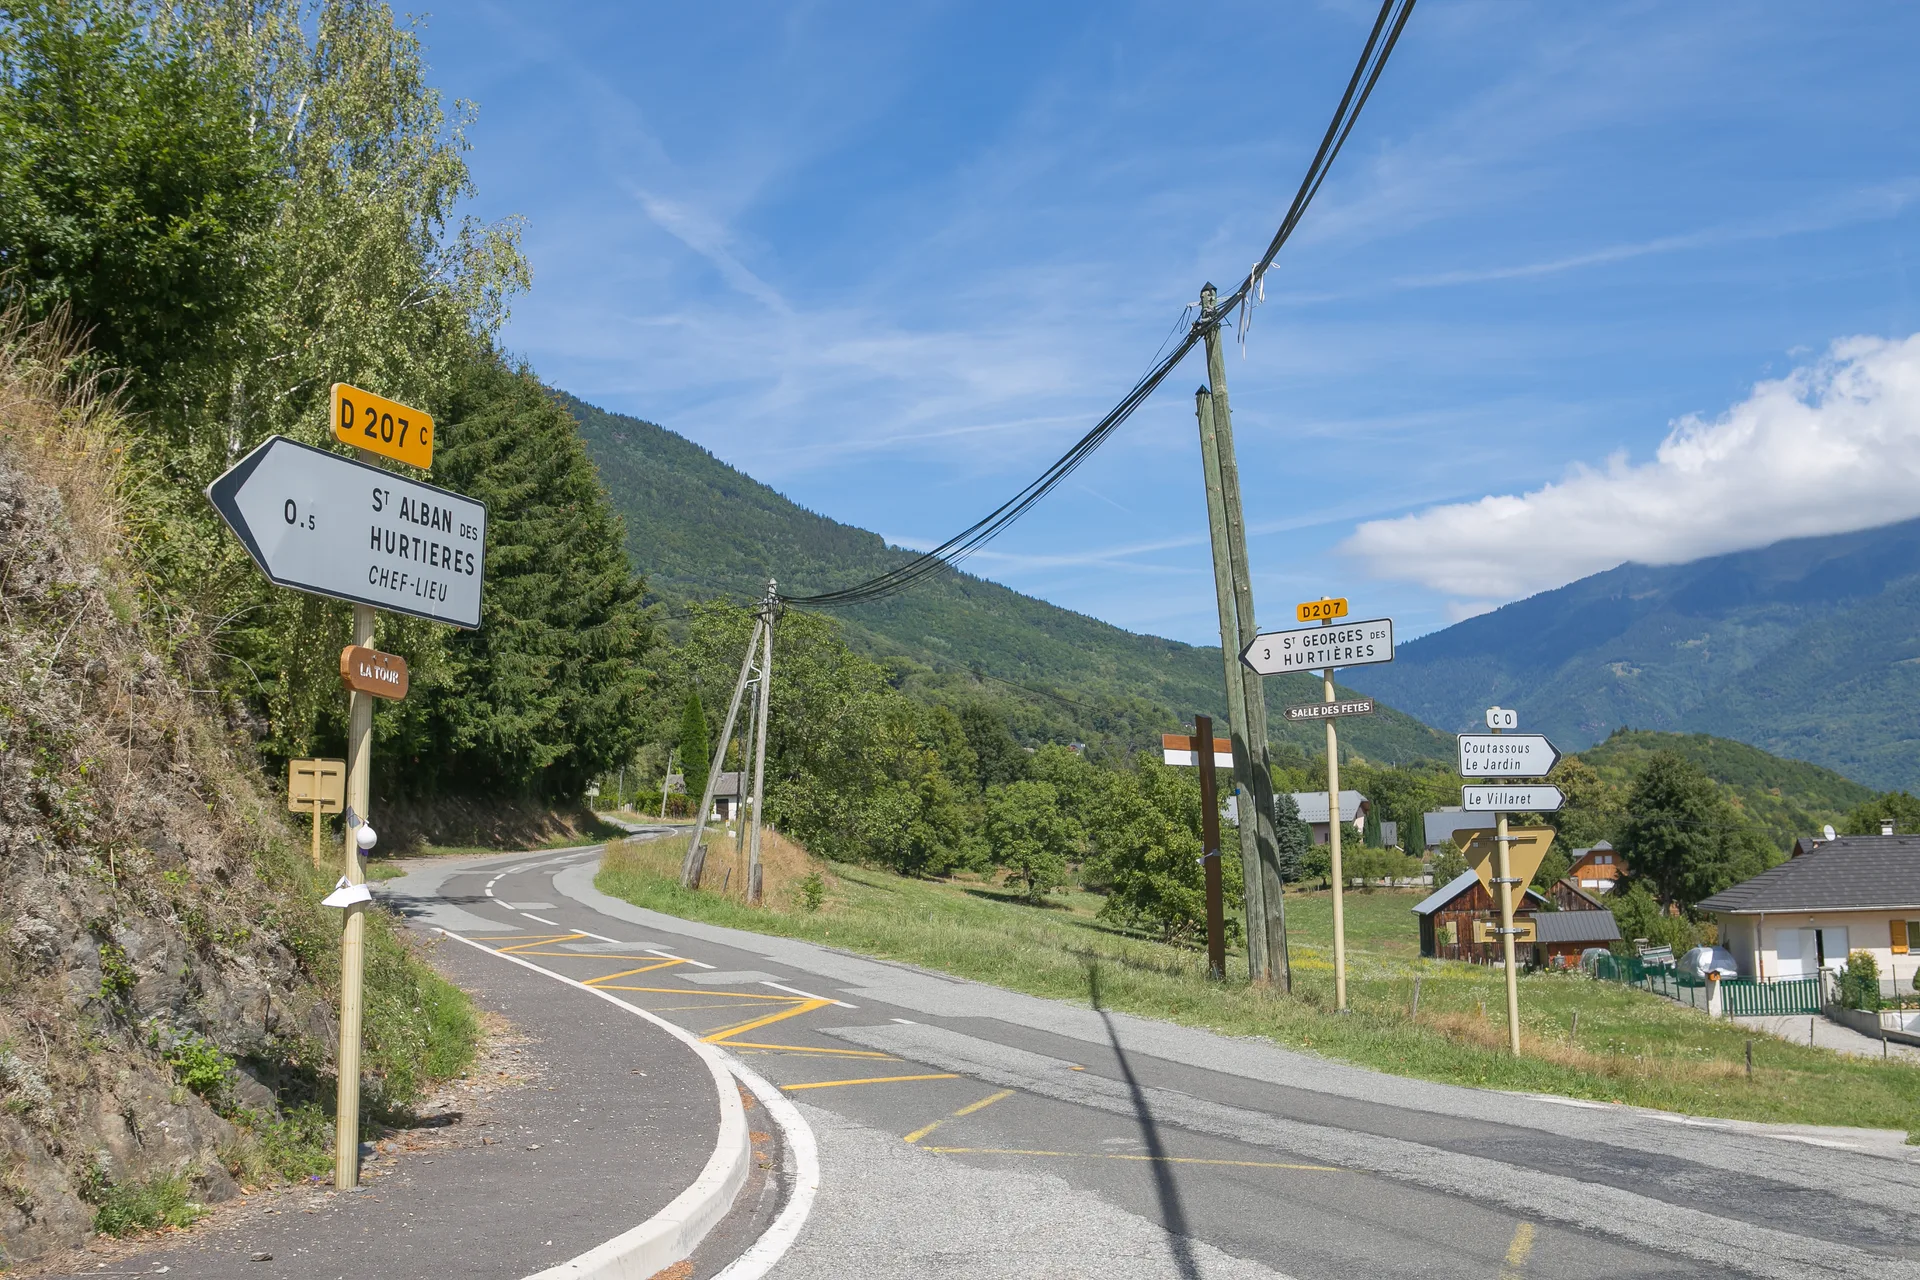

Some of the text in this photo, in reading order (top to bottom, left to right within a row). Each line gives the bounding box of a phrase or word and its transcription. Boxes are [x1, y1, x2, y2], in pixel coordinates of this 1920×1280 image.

[341, 398, 428, 448] D 207 C
[399, 496, 452, 534] ALBAN
[459, 522, 478, 541] DES
[370, 525, 475, 576] HURTIERES
[368, 564, 448, 603] CHEF-LIEU
[1303, 602, 1341, 618] D207
[1303, 629, 1363, 647] GEORGES
[1370, 630, 1386, 640] DES
[1263, 648, 1271, 660] 3
[1284, 644, 1375, 666] HURTIÈRES
[360, 661, 399, 685] LA TOUR
[1291, 705, 1319, 718] SALLE
[1321, 703, 1339, 716] DES
[1464, 741, 1530, 754] Coutassous
[1466, 758, 1521, 770] Le Jardin
[1469, 792, 1531, 805] Le Villaret
